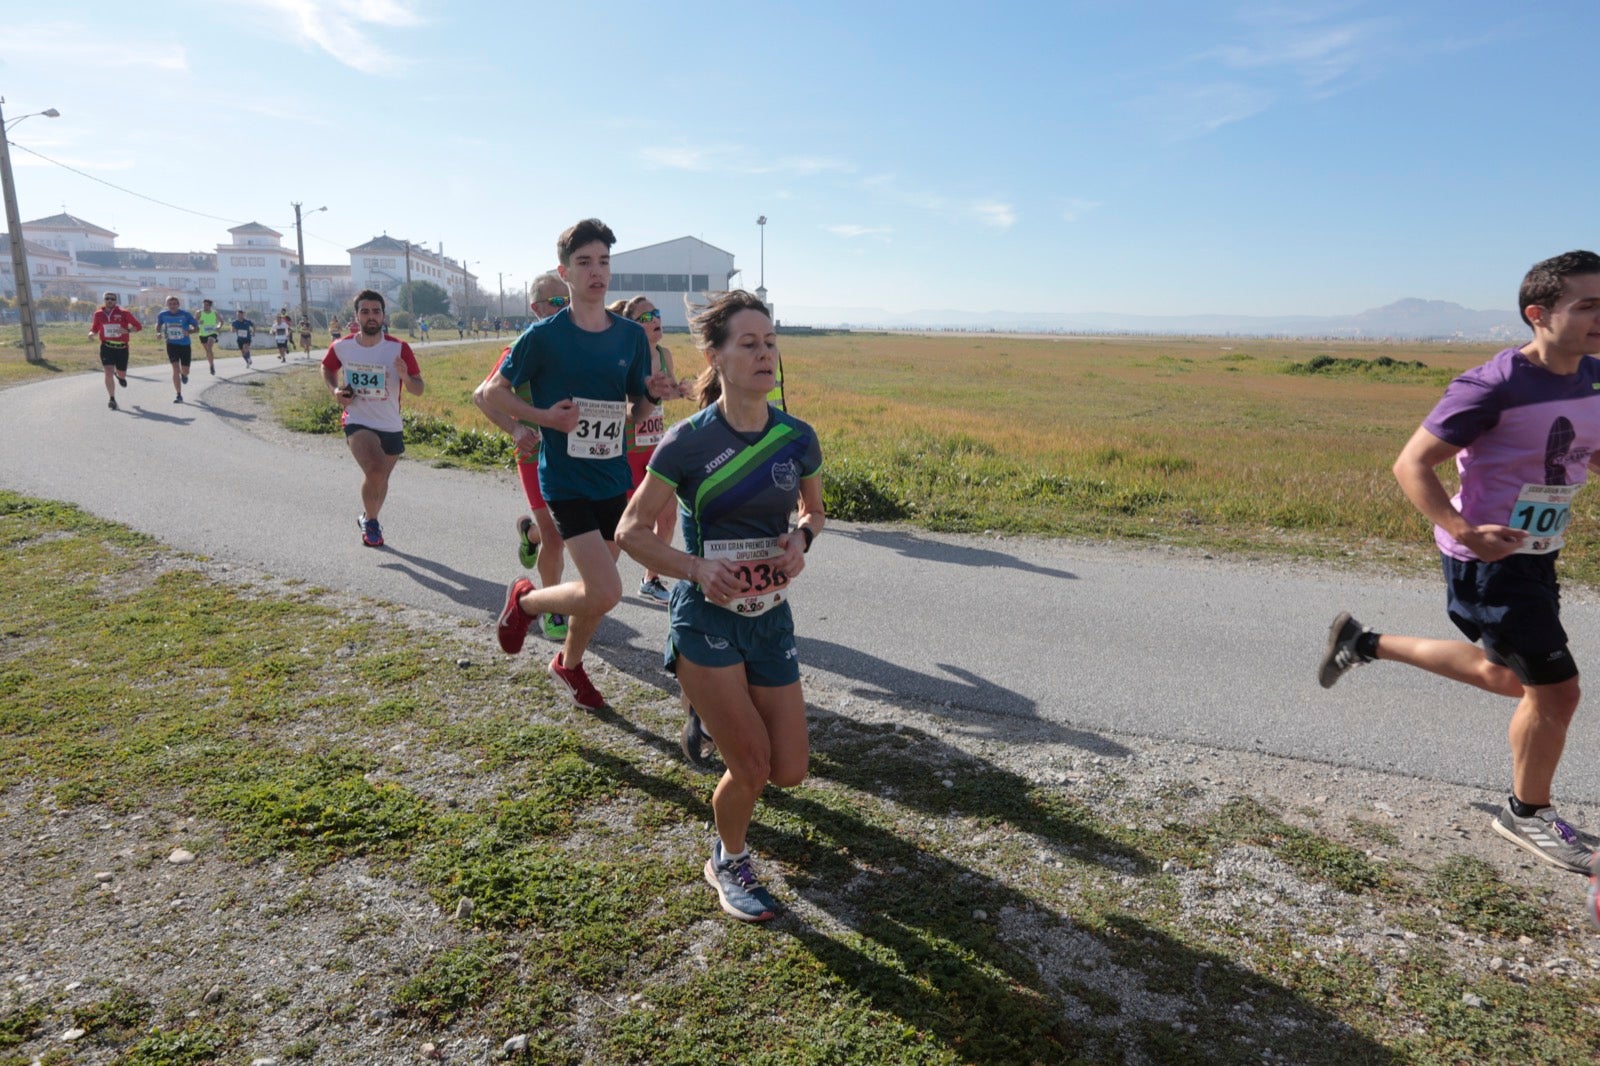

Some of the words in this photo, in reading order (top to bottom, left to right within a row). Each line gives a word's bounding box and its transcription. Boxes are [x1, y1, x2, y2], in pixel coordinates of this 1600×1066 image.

[352, 372, 378, 386] 834
[727, 541, 744, 550] GRAN
[745, 540, 764, 549] PREMIO
